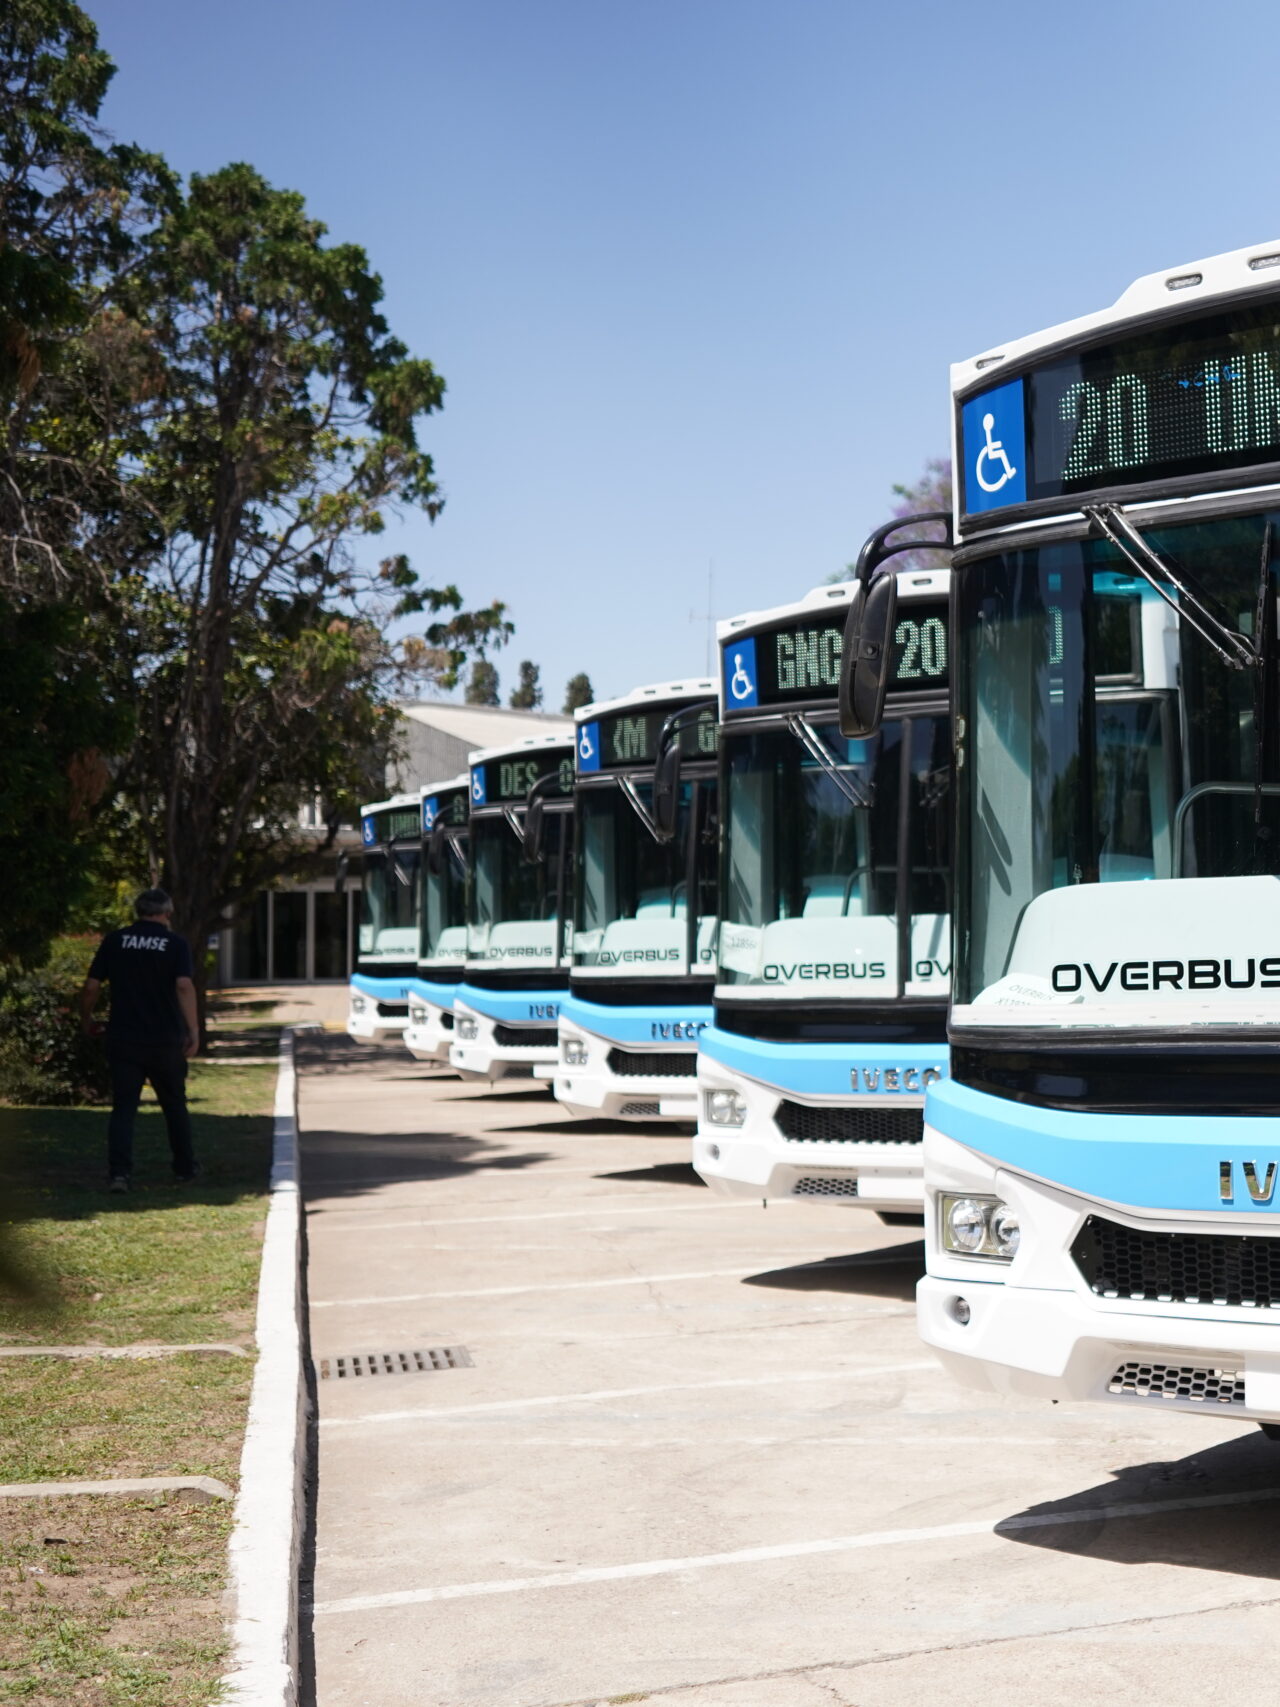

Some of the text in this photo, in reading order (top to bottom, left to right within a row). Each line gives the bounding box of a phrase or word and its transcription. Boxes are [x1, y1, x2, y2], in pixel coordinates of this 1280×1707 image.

[1059, 374, 1149, 480] 20
[776, 617, 947, 689] GNC 20
[121, 934, 169, 952] TAMSE
[489, 946, 553, 958] OVERBUS
[600, 948, 680, 964] OVERBUS
[763, 962, 886, 981] OVERBUS
[529, 1004, 560, 1019] IVE
